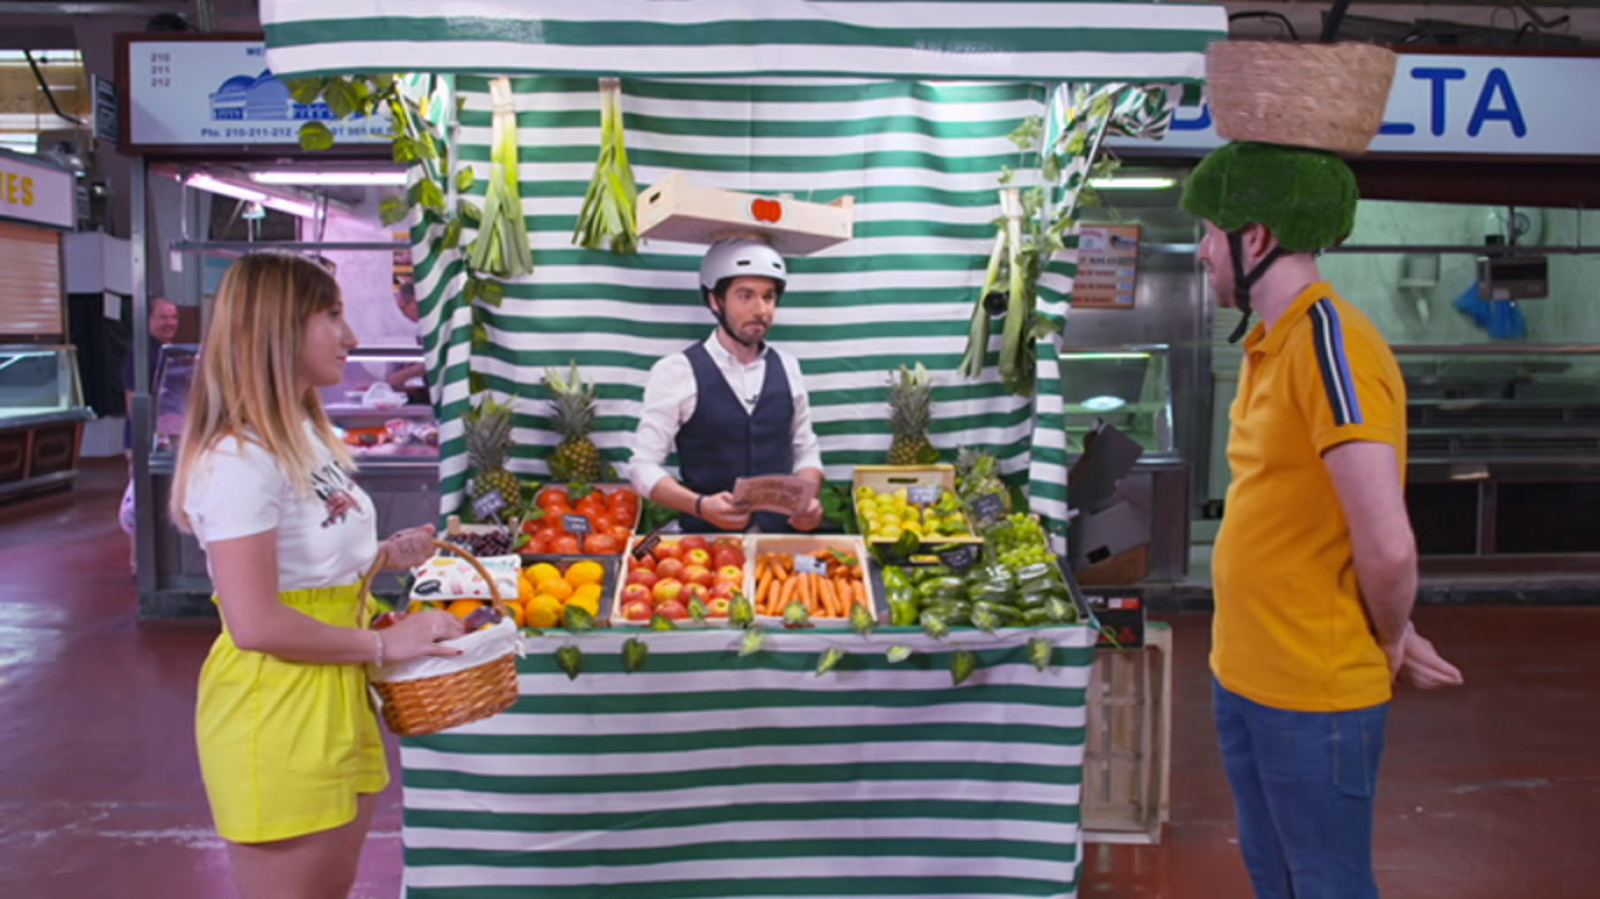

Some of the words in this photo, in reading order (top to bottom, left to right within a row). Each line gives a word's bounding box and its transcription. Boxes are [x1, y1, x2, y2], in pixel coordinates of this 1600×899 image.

[150, 52, 171, 63] 210
[150, 65, 171, 75] 211
[150, 77, 171, 87] 212
[0, 170, 36, 207] ES
